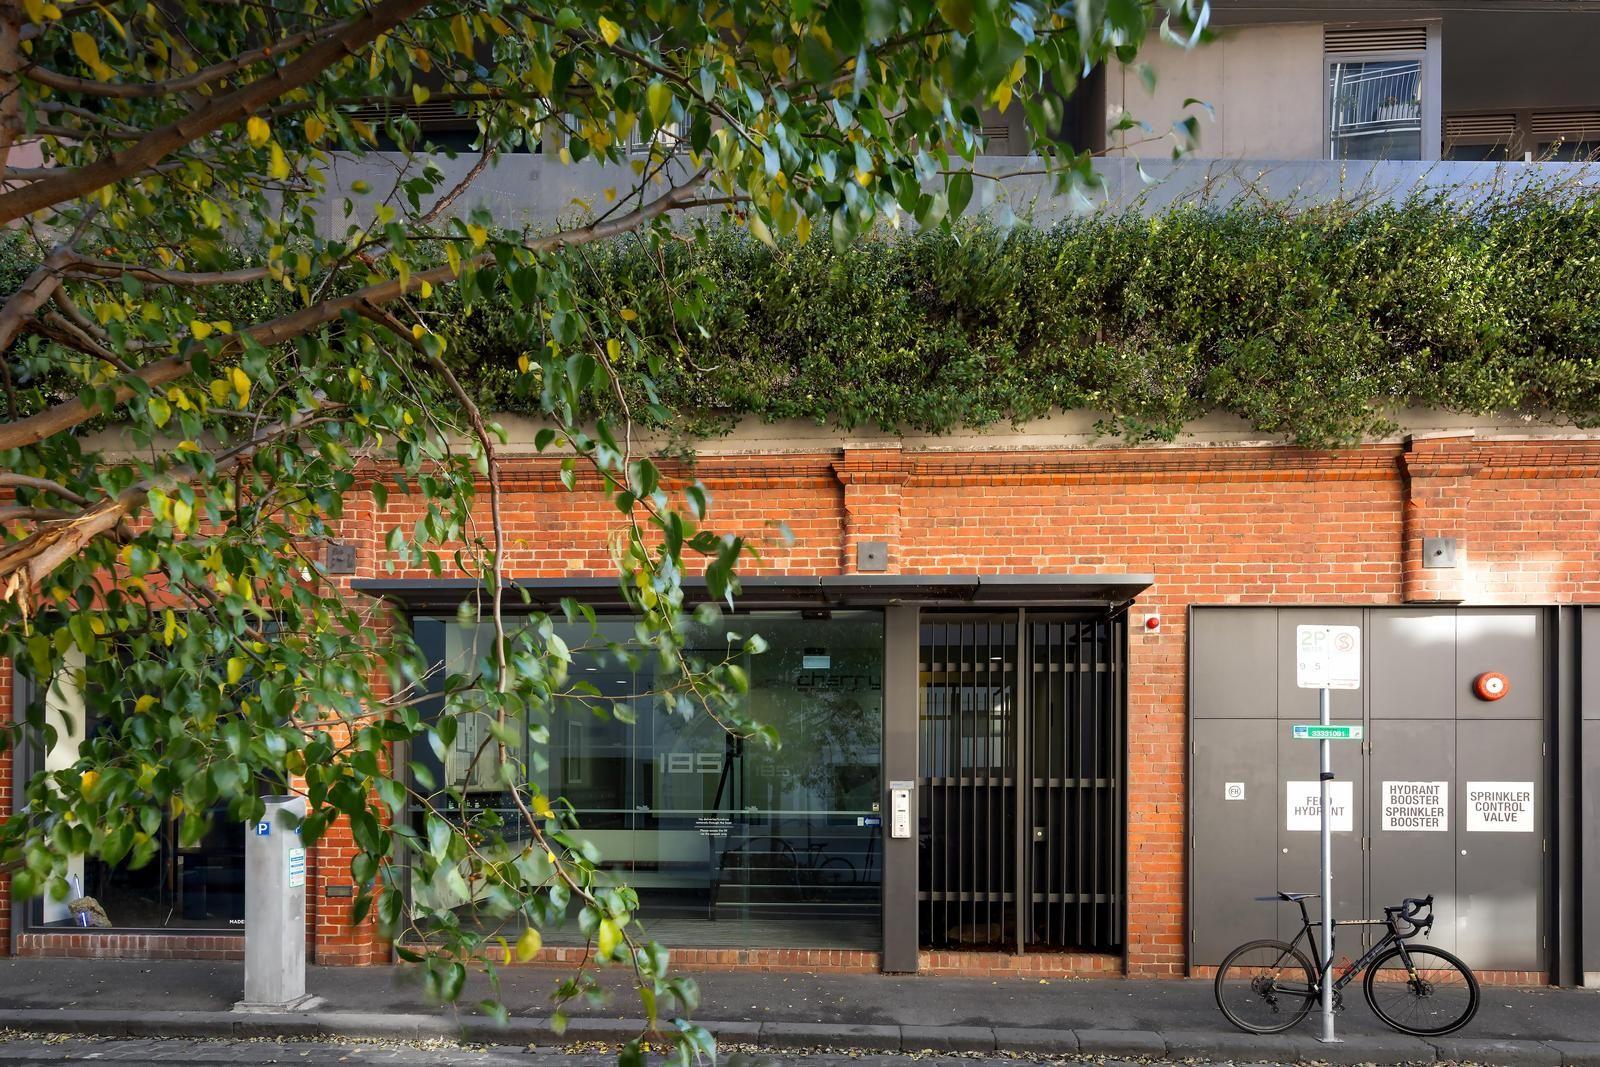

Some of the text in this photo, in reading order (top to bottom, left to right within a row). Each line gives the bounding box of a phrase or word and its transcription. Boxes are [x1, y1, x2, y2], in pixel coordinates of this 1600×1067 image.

[1301, 631, 1326, 646] 2P
[660, 752, 722, 774] 185
[1389, 785, 1441, 795] HYDRANT
[1390, 795, 1439, 805] BOOSTER
[1470, 791, 1530, 802] SPRINKLER
[1385, 806, 1444, 817] SPRINKLER
[1475, 802, 1526, 812] CONTROL
[1390, 817, 1439, 827] BOOSTER
[1483, 812, 1518, 822] VALVE
